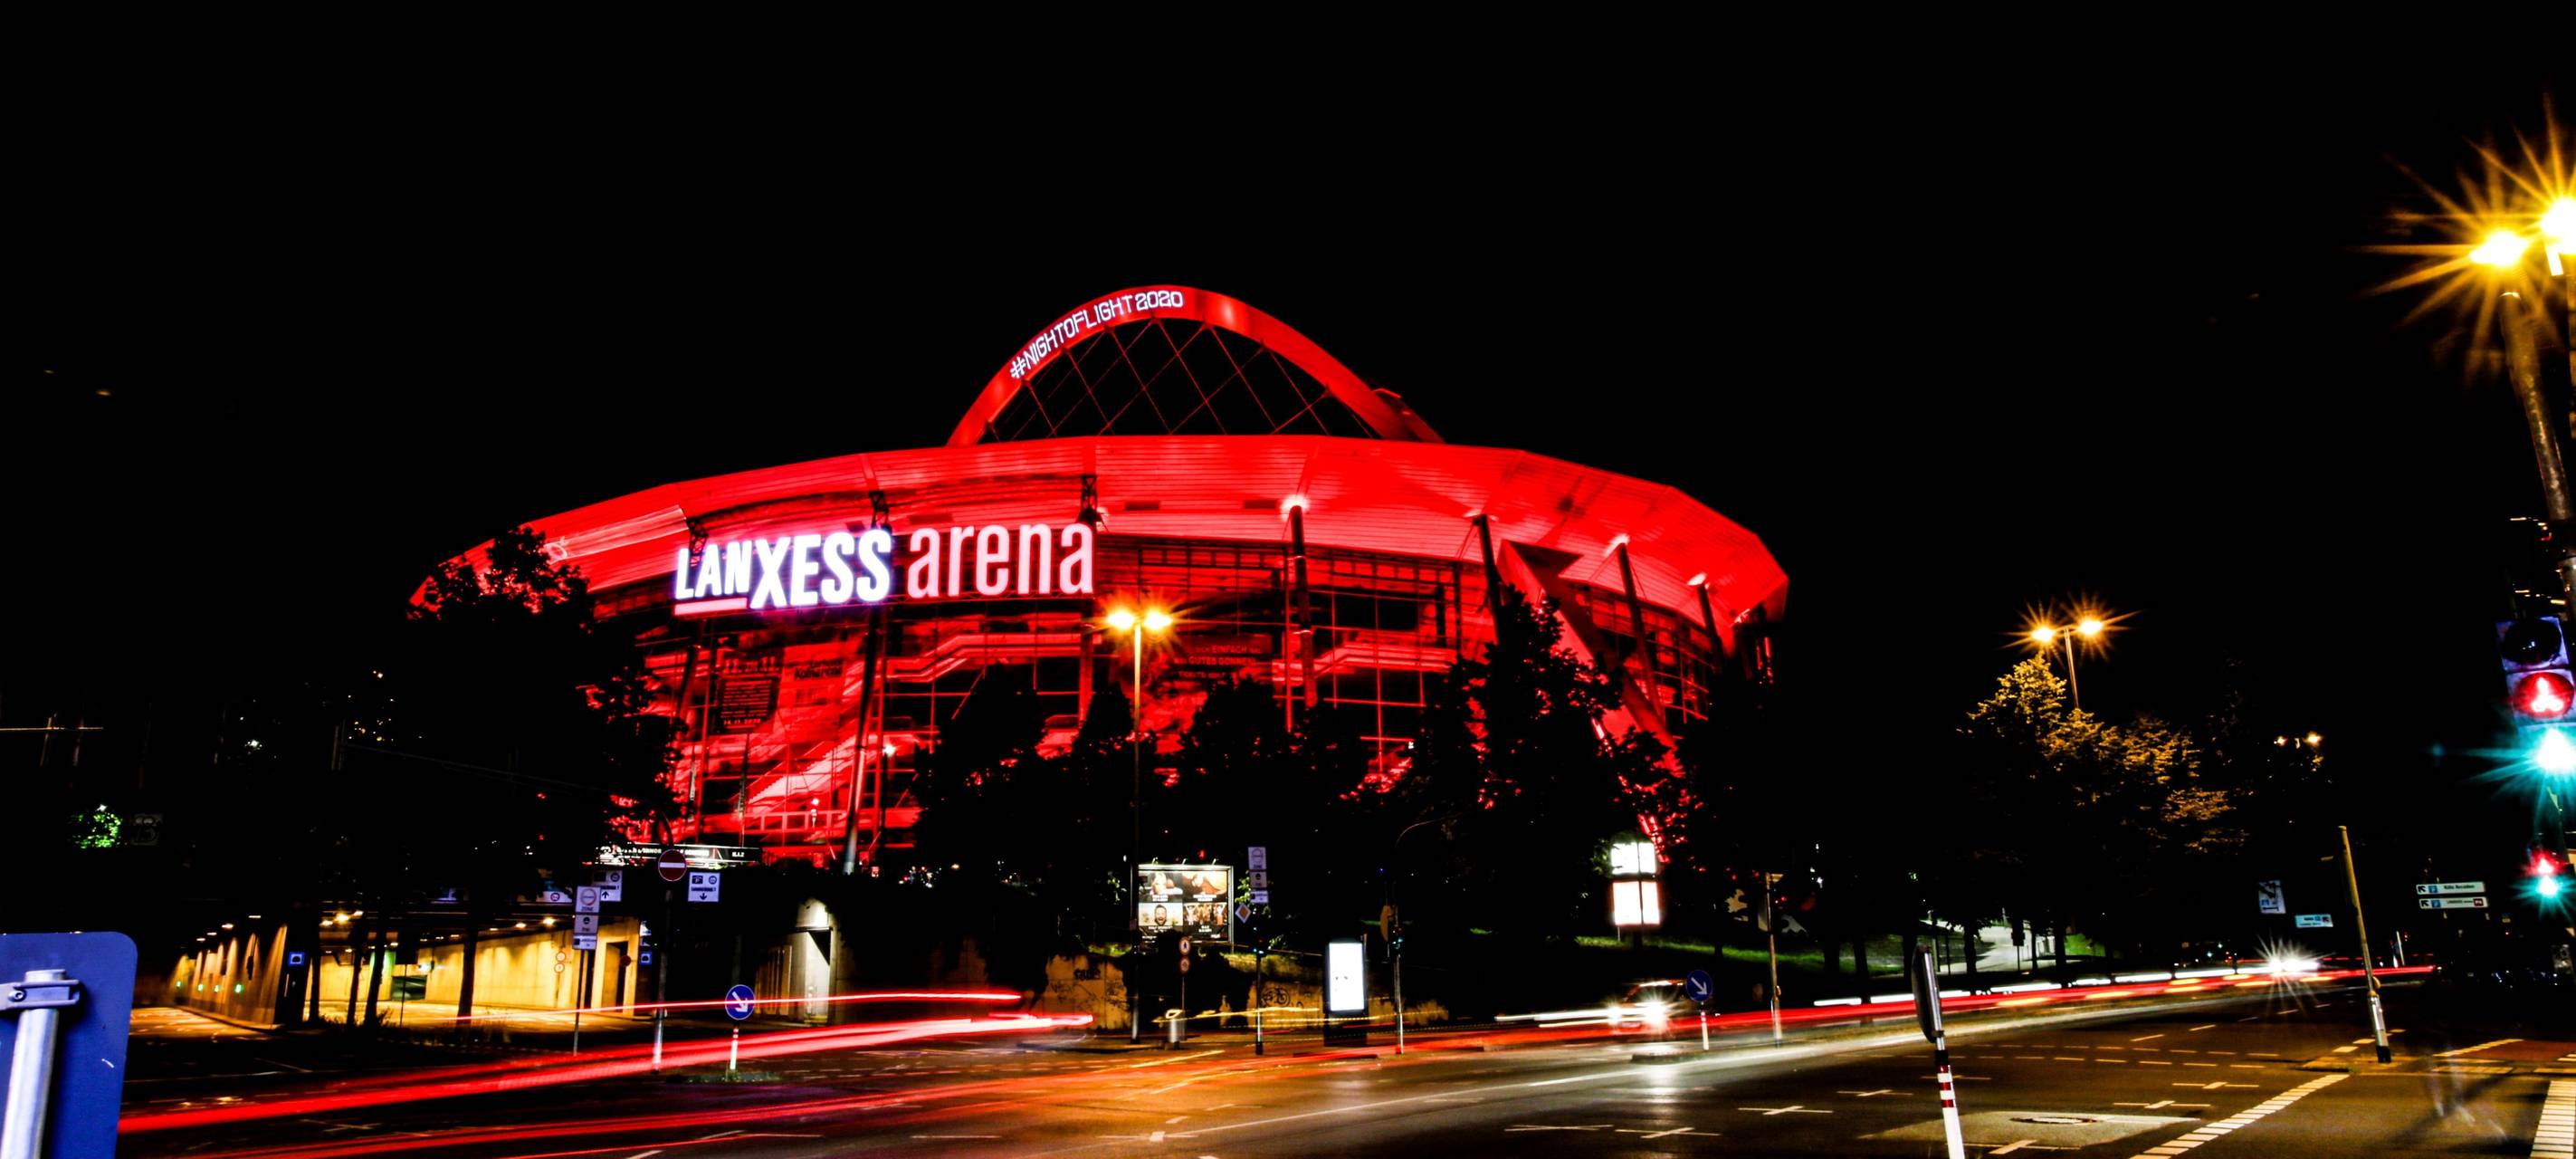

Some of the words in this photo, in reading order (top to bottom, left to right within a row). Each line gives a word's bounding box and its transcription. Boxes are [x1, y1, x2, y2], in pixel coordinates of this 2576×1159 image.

[1010, 289, 1184, 378] #NIGHTOFLIGHT2020
[674, 528, 892, 609] LANXESS
[907, 522, 1094, 599] arena
[1212, 645, 1247, 654] EINFACH
